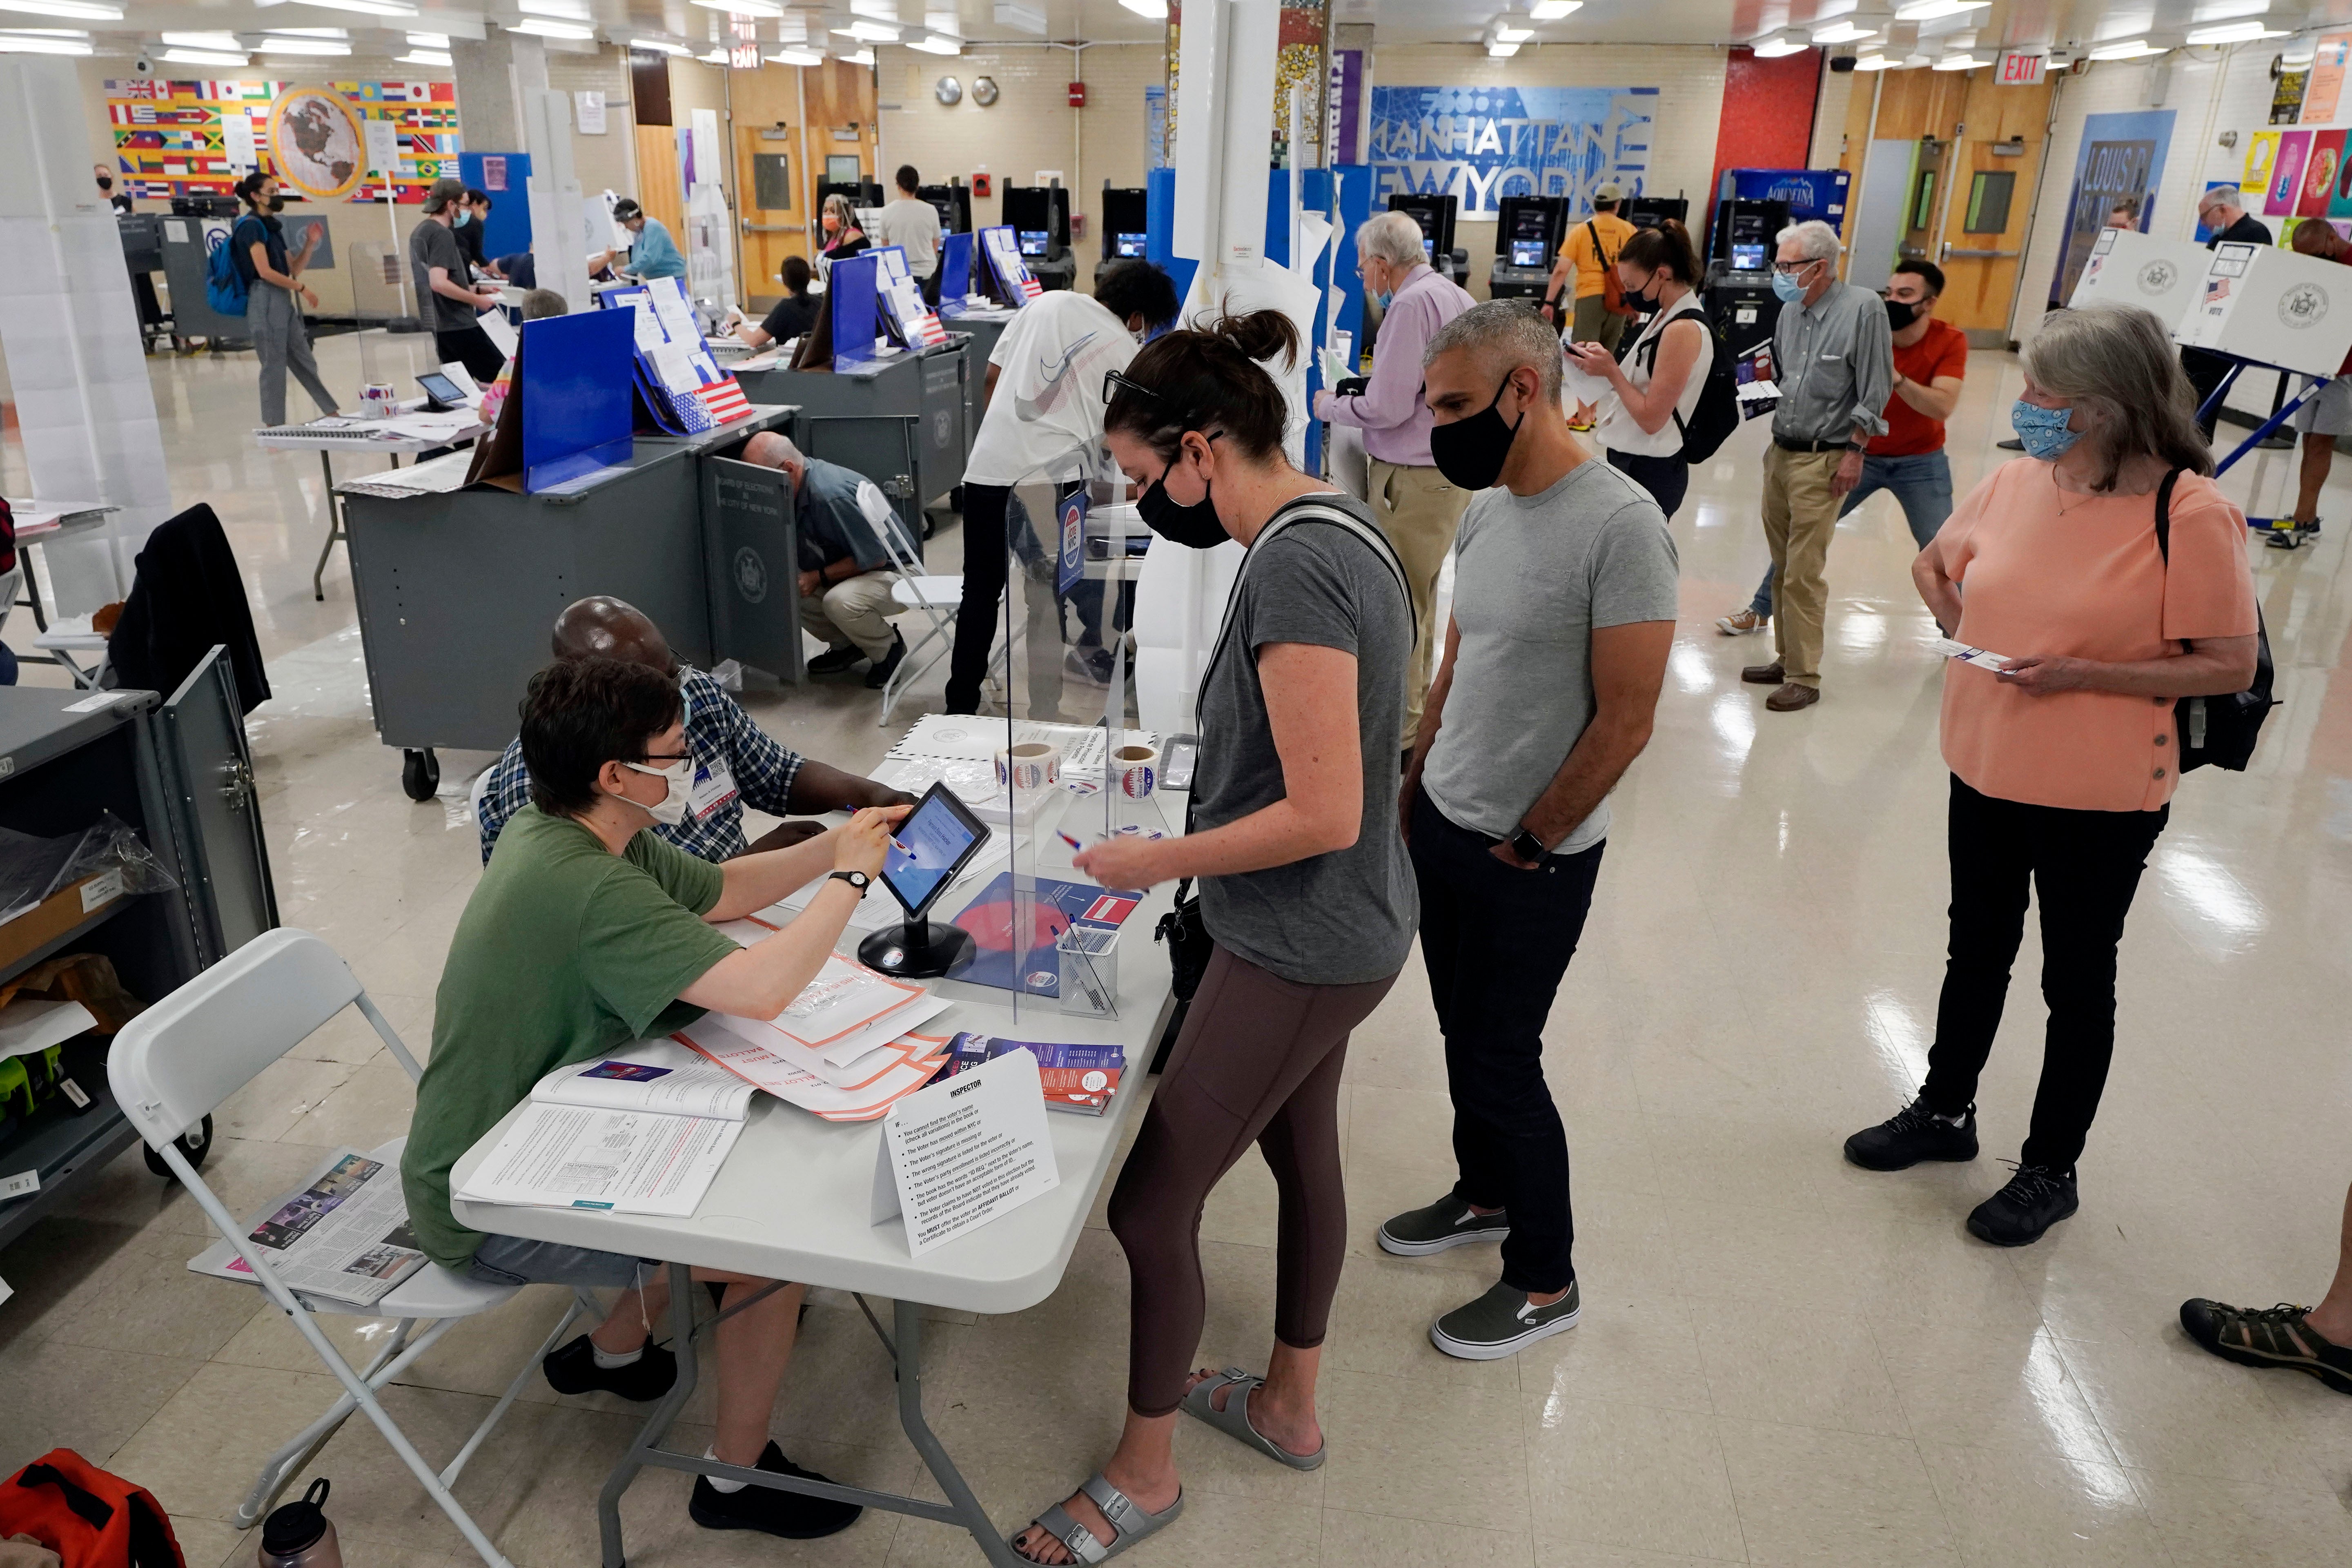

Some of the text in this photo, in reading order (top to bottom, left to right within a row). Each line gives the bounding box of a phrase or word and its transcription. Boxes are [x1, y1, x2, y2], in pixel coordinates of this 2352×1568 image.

[2004, 55, 2038, 80] EXIT
[2084, 147, 2132, 193] LOUIS
[2208, 307, 2223, 316] VOTE
[1067, 525, 1076, 539] VOTE
[1068, 536, 1076, 550] NYC
[1088, 731, 1102, 743] Carpeta
[1071, 745, 1085, 759] Papeleta
[1077, 747, 1092, 764] Privacidad
[1092, 754, 1104, 765] Sleeve
[719, 1047, 764, 1058] BALLOTS
[781, 1075, 815, 1085] ALLOT
[950, 1079, 981, 1098] INSPECTOR
[905, 1134, 921, 1145] (check
[927, 1121, 950, 1135] variations)
[962, 1111, 974, 1119] book
[913, 1123, 929, 1133] cannot
[929, 1118, 938, 1127] find
[947, 1109, 961, 1119] voter's
[961, 1104, 973, 1113] name
[706, 1145, 715, 1154] Ballot
[711, 1132, 723, 1145] Affidavit
[916, 1143, 929, 1151] Voter
[939, 1131, 953, 1142] moved
[953, 1126, 967, 1135] within
[967, 1121, 976, 1129] NYC
[918, 1152, 935, 1162] Voter's
[935, 1143, 956, 1156] signature
[960, 1133, 977, 1144] missing
[921, 1164, 936, 1174] wrong
[936, 1155, 957, 1167] signature
[961, 1146, 973, 1156] listed
[987, 1135, 997, 1143] voter
[923, 1174, 939, 1184] Voter's
[940, 1169, 951, 1179] party
[952, 1158, 974, 1172] enrollment
[978, 1149, 990, 1159] listed
[990, 1140, 1011, 1154] incorrectly
[925, 1187, 937, 1196] book
[954, 1173, 968, 1183] words
[987, 1158, 997, 1167] next
[1008, 1146, 1022, 1156] Voter's
[1022, 1140, 1033, 1149] name,
[921, 1214, 938, 1225] records
[952, 1200, 965, 1211] Board
[965, 1193, 982, 1204] indicate
[982, 1187, 991, 1196] that
[991, 1183, 1000, 1192] they
[1000, 1178, 1009, 1187] have
[1010, 1171, 1024, 1182] already
[1024, 1165, 1036, 1174] voted.
[926, 1194, 938, 1203] voter
[938, 1186, 954, 1198] doesn't
[954, 1182, 965, 1190] have
[972, 1168, 993, 1182] acceptable
[929, 1205, 941, 1214] Voter
[941, 1198, 956, 1208] claims
[961, 1190, 972, 1199] have
[972, 1185, 981, 1194] NOT
[981, 1179, 993, 1189] voted
[1005, 1165, 1020, 1176] election
[927, 1223, 940, 1234] MUST
[941, 1219, 951, 1228] offer
[960, 1210, 971, 1218] voter
[978, 1195, 998, 1210] AFFIDAVIT
[999, 1186, 1014, 1199] BALLOT
[922, 1229, 946, 1243] Certificate
[951, 1220, 965, 1230] obtain
[969, 1212, 981, 1221] Court
[981, 1206, 994, 1215] Order.
